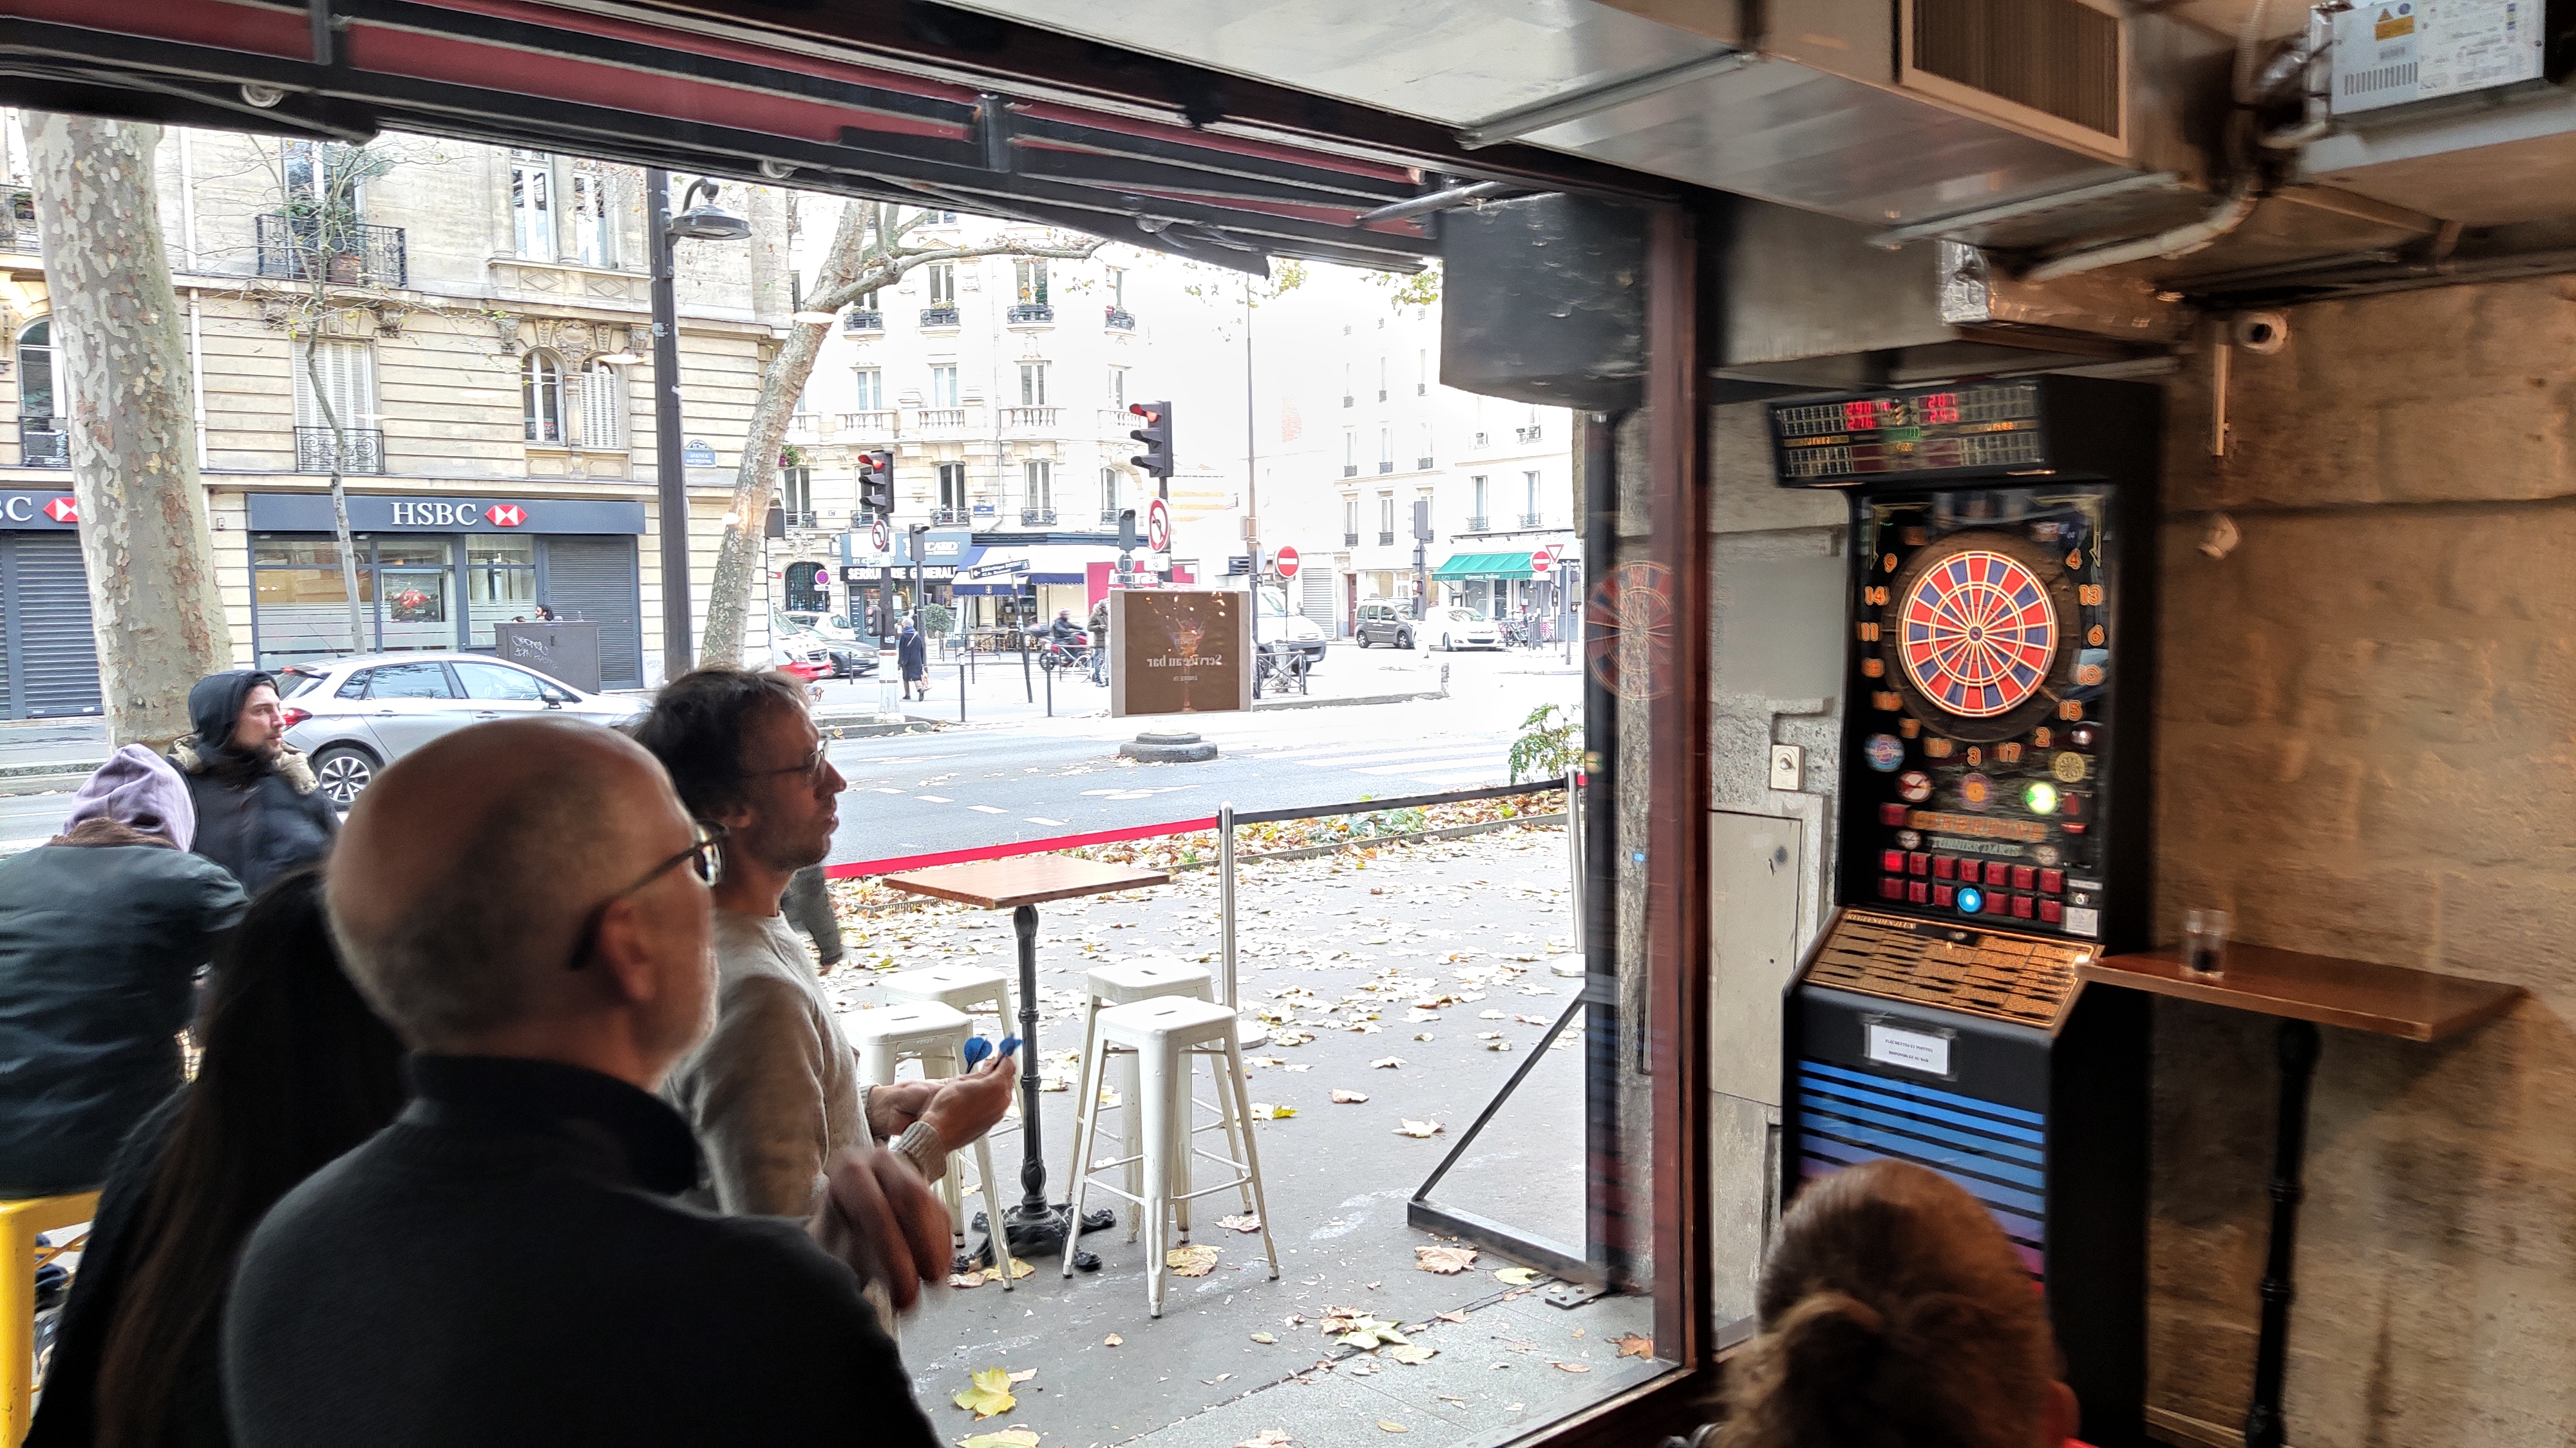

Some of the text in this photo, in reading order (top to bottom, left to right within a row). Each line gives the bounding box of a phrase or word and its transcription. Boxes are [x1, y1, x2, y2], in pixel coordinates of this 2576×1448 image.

[390, 502, 478, 526] HSBC
[1884, 553, 1897, 573] 9
[2066, 548, 2082, 570] 4
[1864, 586, 1888, 605] 14
[2078, 584, 2103, 605] 13
[1861, 622, 1880, 642] 11
[2087, 624, 2105, 646] 6
[2077, 664, 2101, 686] 10
[2060, 700, 2082, 721] 15
[2035, 727, 2051, 747] 2
[1967, 745, 1982, 767] 3
[1998, 741, 2022, 763] 17
